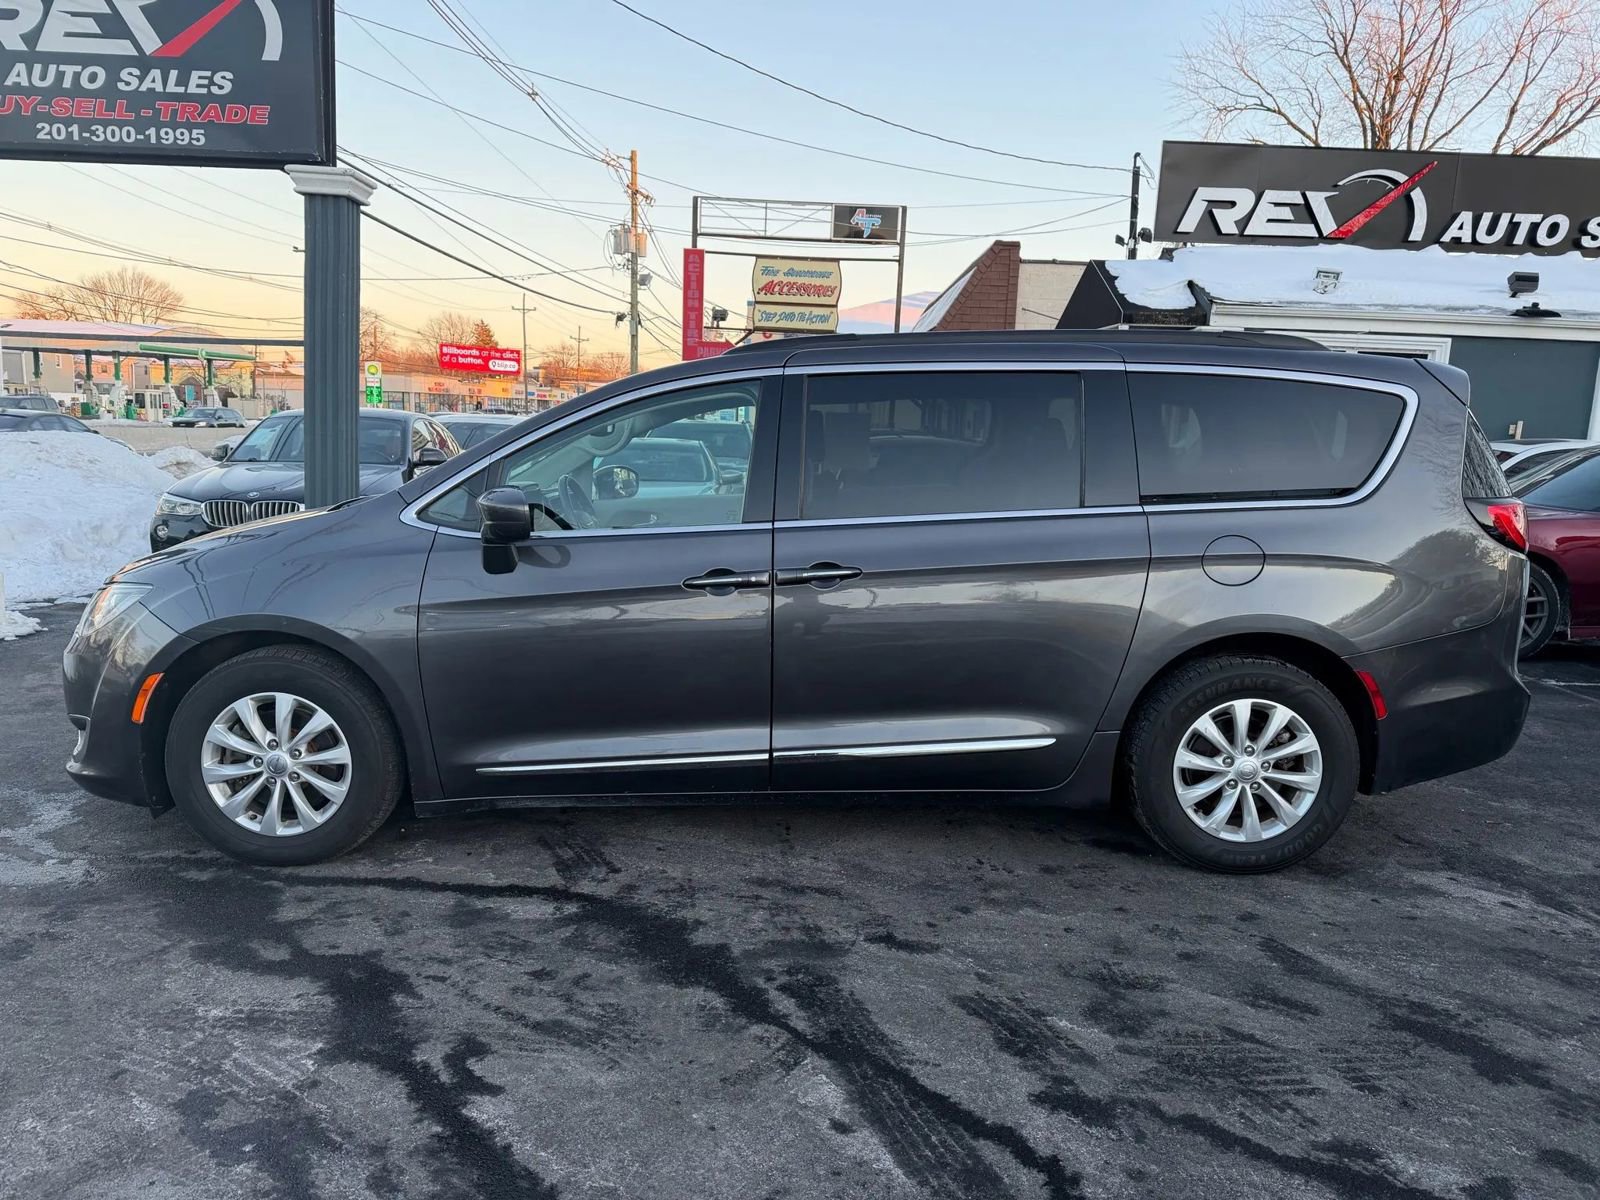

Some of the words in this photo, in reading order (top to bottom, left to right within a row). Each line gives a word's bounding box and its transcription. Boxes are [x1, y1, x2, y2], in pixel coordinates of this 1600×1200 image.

[4, 62, 106, 90] AUTO
[117, 68, 234, 95] SALES
[0, 94, 270, 125] UY-SELL-TRADE
[36, 122, 206, 146] 201-300-1995
[1440, 211, 1570, 247] AUTO
[757, 280, 838, 297] ACCESSORIES
[442, 346, 480, 356] Billboards
